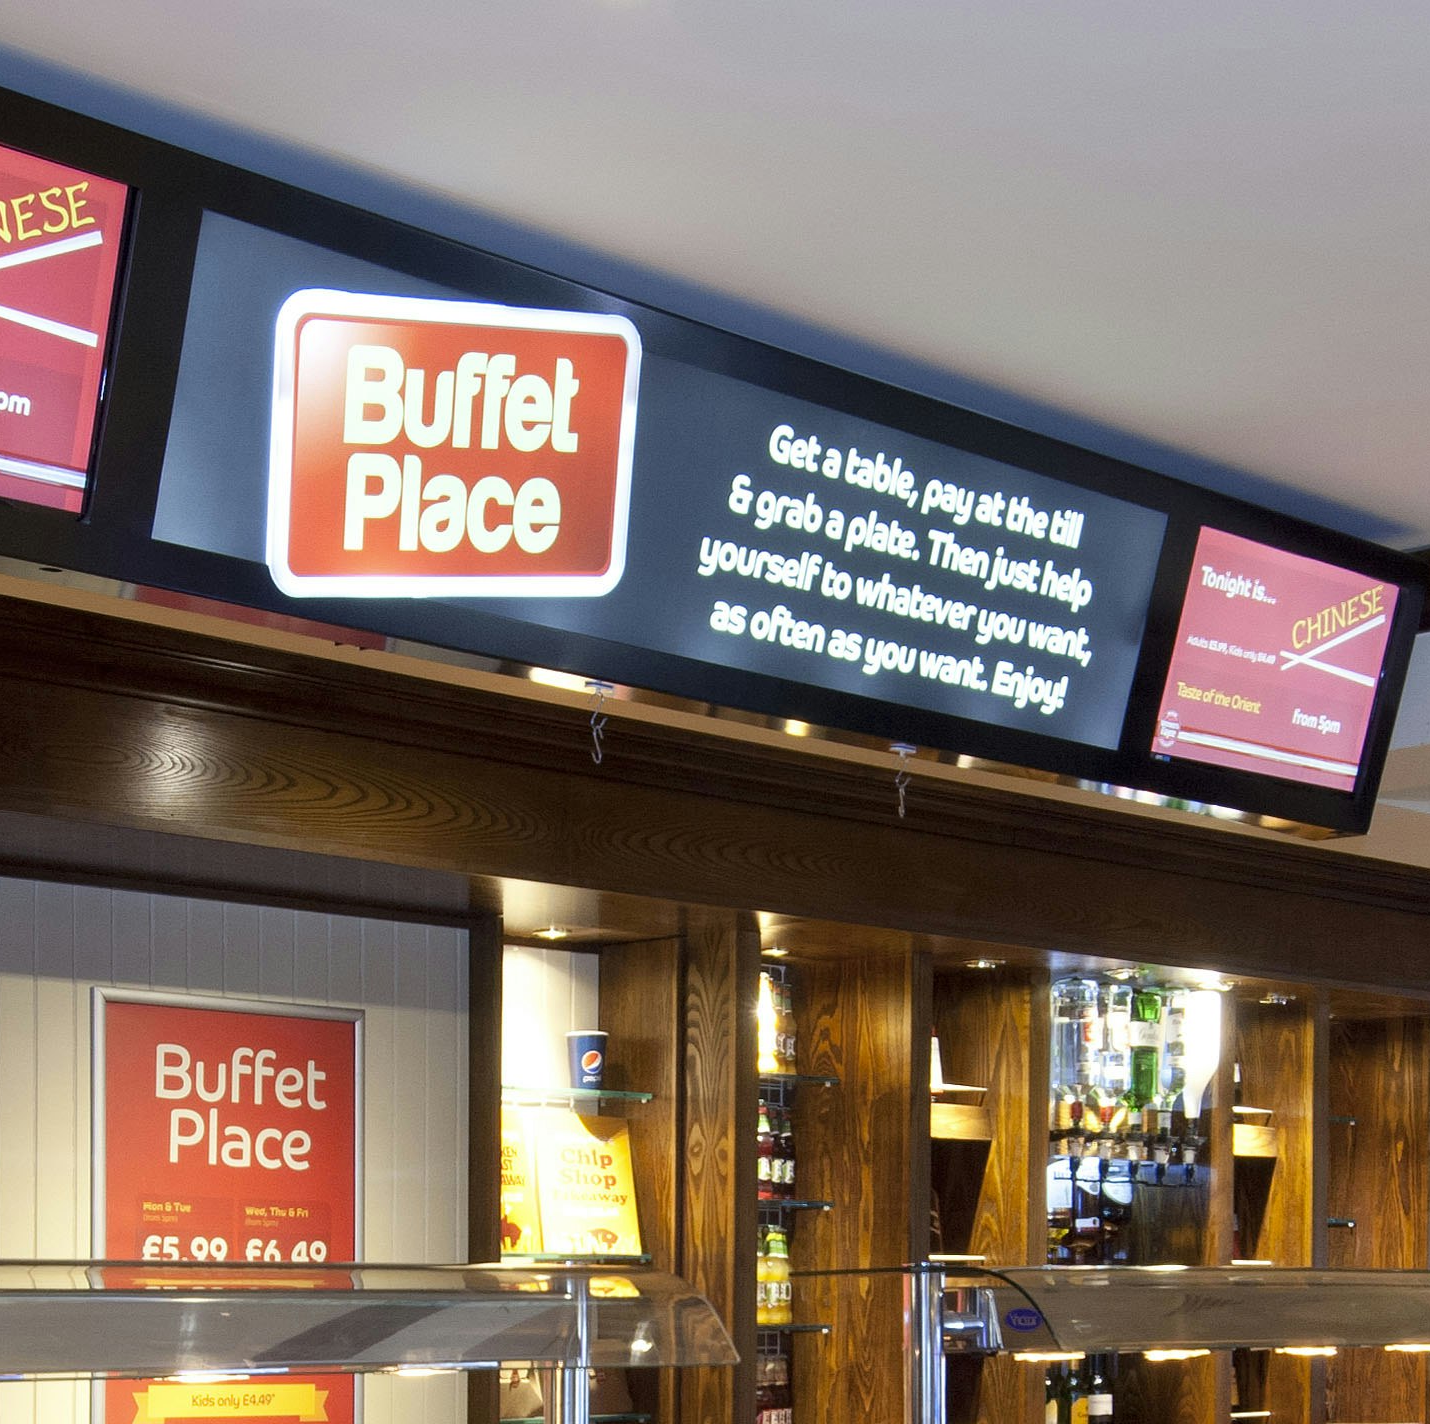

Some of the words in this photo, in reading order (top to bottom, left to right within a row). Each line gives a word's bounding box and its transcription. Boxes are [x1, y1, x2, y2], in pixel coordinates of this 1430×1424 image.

[343, 344, 579, 453] Buffet
[343, 452, 561, 554] Place
[768, 424, 821, 473] Get
[821, 447, 842, 479] a
[844, 447, 920, 509] table,
[920, 478, 975, 526] pay
[975, 491, 1005, 527] at
[1006, 495, 1048, 539] the
[1049, 508, 1084, 548] till
[728, 474, 753, 515] &
[754, 489, 823, 533] grab
[825, 508, 844, 540] a
[844, 510, 920, 561] plate.
[927, 528, 990, 579] Then
[984, 545, 1040, 594] just
[1040, 560, 1092, 613] help
[698, 536, 822, 592] yourself
[821, 561, 852, 600] to
[856, 573, 977, 630] whatever
[976, 608, 1029, 645] you
[1028, 623, 1092, 667] want,
[1201, 565, 1252, 598] Tonight
[1251, 579, 1277, 605] is...
[1291, 585, 1384, 649] CHINESE
[709, 600, 746, 635] as
[749, 604, 825, 654] often
[827, 628, 862, 662] as
[862, 636, 918, 675] you
[919, 651, 988, 691] want.
[991, 660, 1069, 715] Enjoy!
[1177, 681, 1202, 700] Taste
[1202, 689, 1216, 703] of
[1215, 690, 1231, 707] the
[1231, 695, 1261, 714] Orient
[1291, 708, 1319, 730] from
[1319, 714, 1341, 735] 5pm
[155, 1043, 327, 1110] Buffet
[169, 1107, 312, 1171] Place
[143, 1201, 163, 1212] Mon
[164, 1202, 172, 1212] &
[174, 1202, 192, 1213] Tue
[244, 1207, 268, 1218] Wed,
[269, 1207, 287, 1217] Thu
[288, 1207, 296, 1217] &
[296, 1208, 309, 1218] Fri
[245, 1238, 327, 1262] £649
[191, 1394, 215, 1408] Kids
[217, 1394, 240, 1409] only
